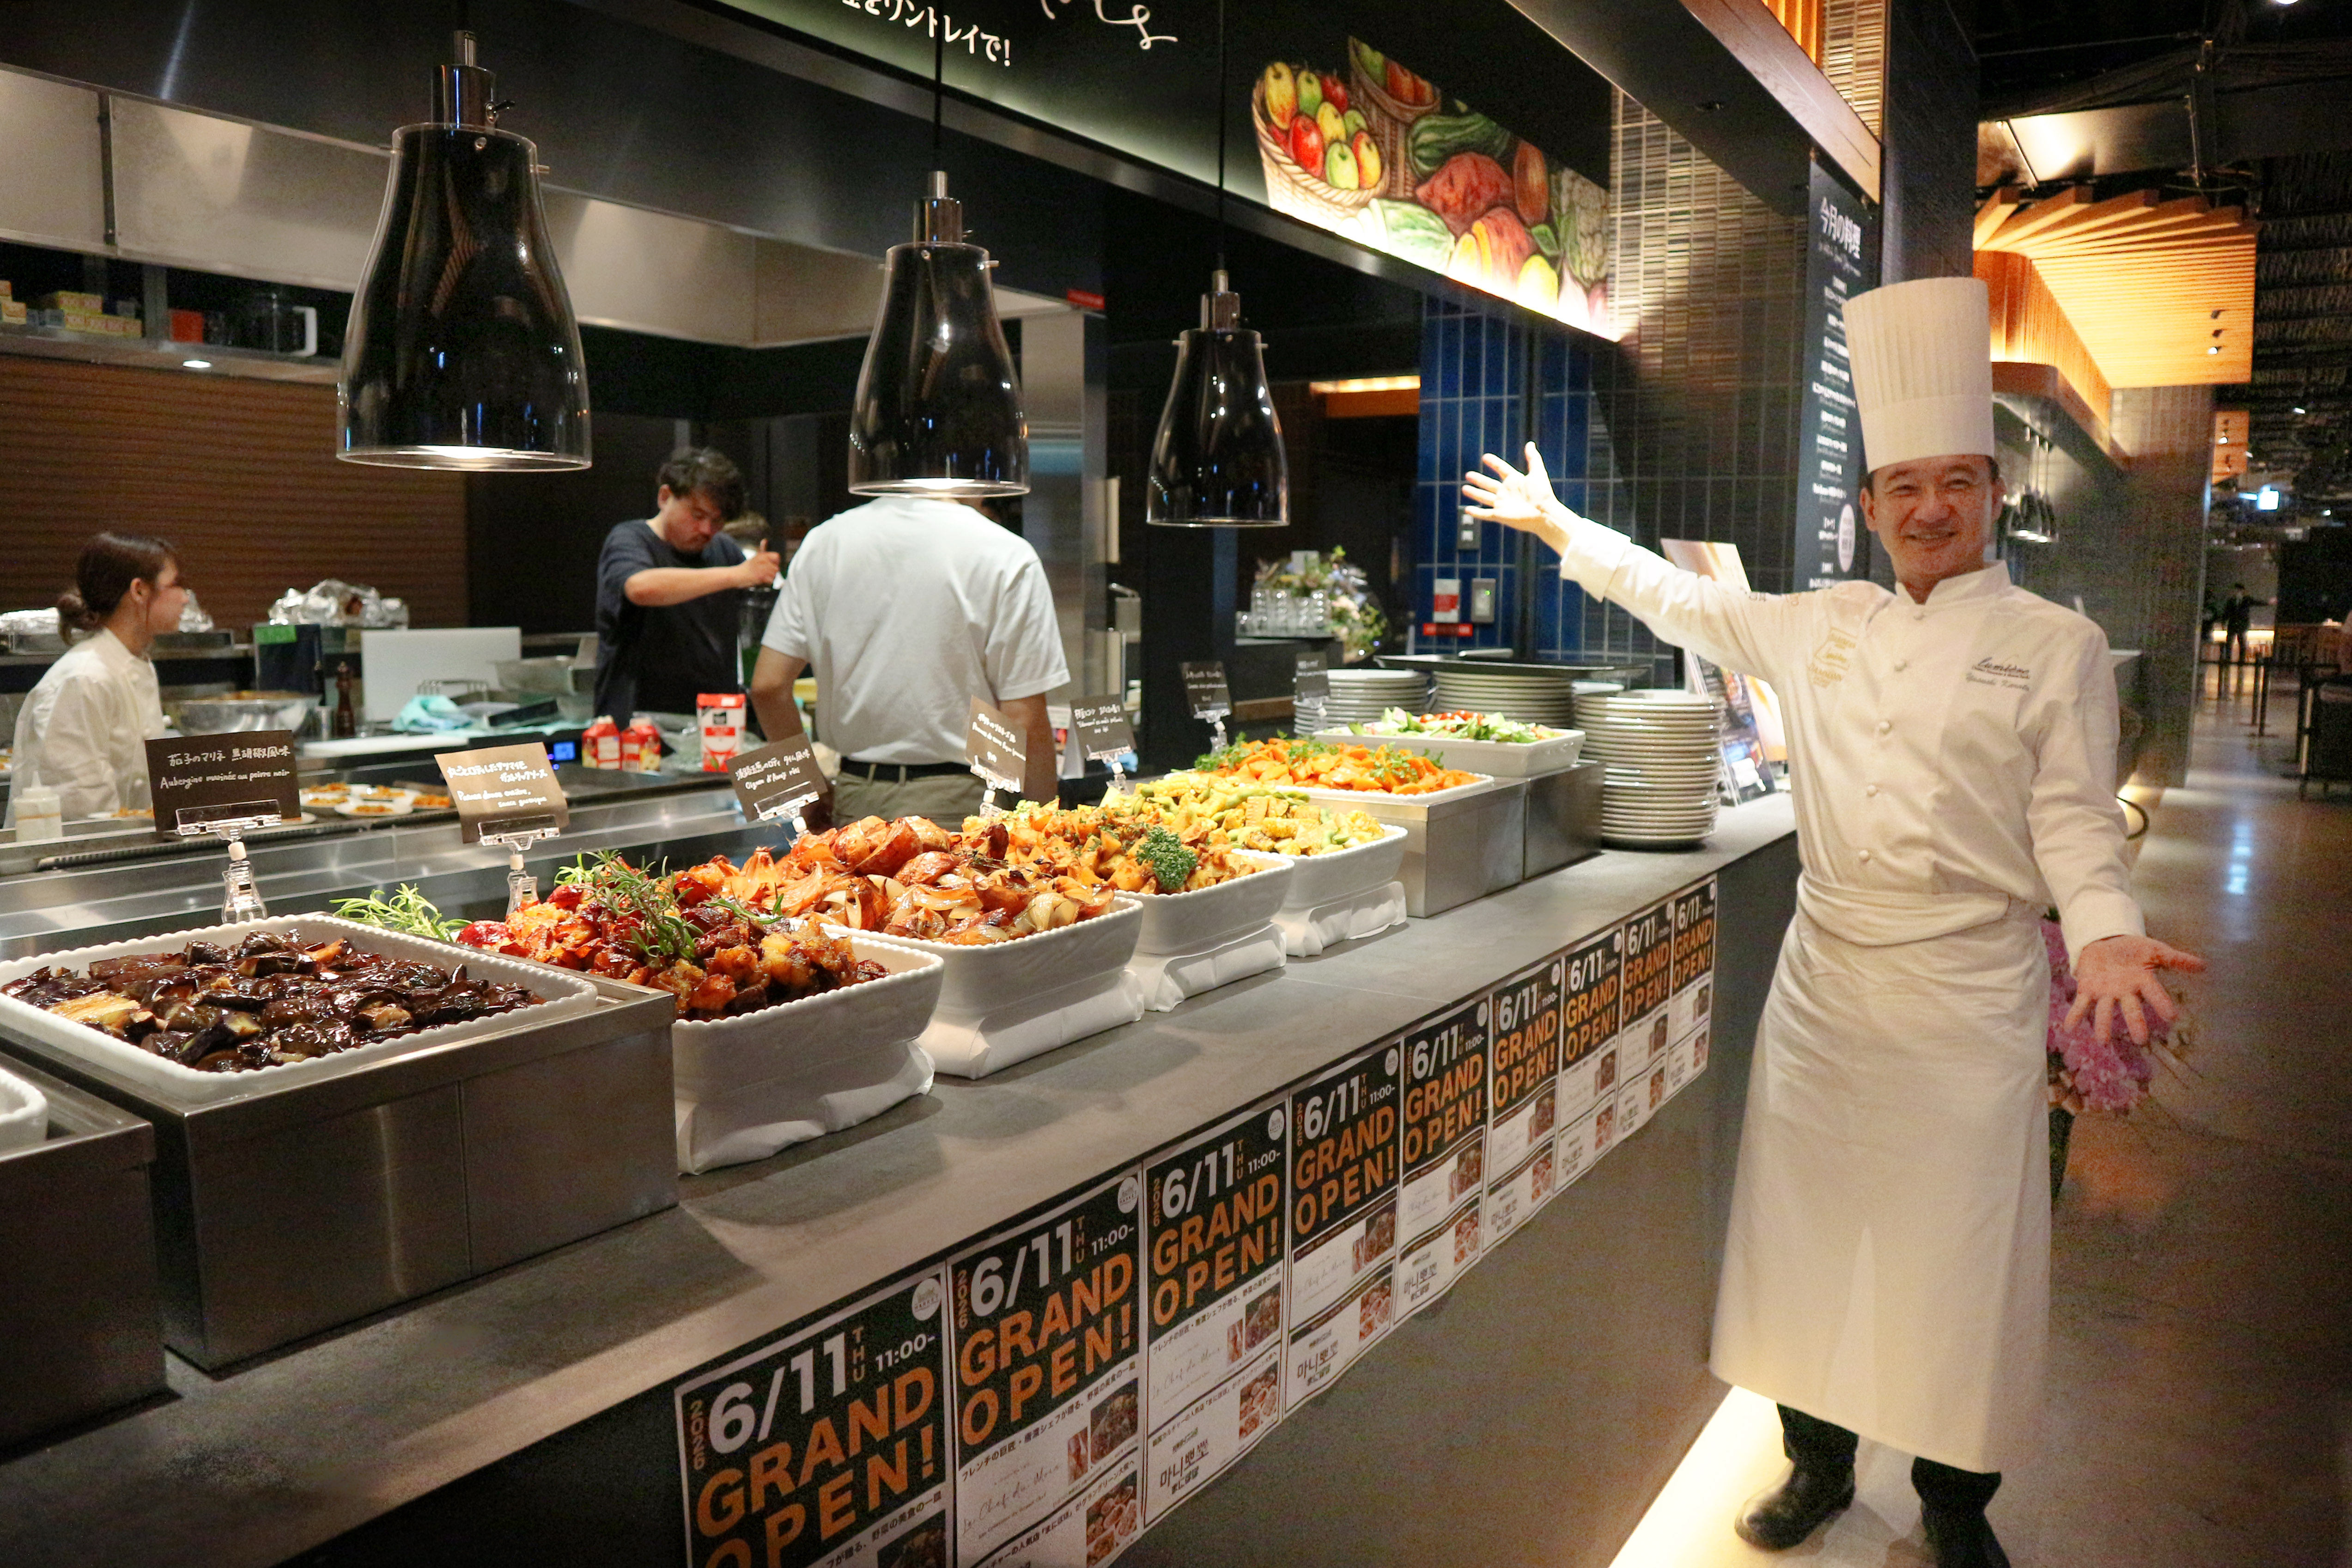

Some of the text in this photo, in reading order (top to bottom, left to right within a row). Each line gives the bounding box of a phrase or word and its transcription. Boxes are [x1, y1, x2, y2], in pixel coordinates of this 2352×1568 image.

[842, 0, 1010, 67] をワントレイで!
[160, 777, 203, 789] Aubergine
[167, 745, 291, 767] 茄子のマリネ 黒胡椒風味
[1628, 916, 1655, 955] 6/11
[1674, 918, 1713, 961] GRAND
[1678, 895, 1700, 930] 6/11
[1570, 948, 1603, 991] 6/11
[1623, 941, 1670, 990] GRAND
[1672, 944, 1711, 989] OPEN!
[1499, 982, 1538, 1031] 6/11
[1565, 974, 1617, 1029] GRAND
[1622, 970, 1668, 1022] OPEN!
[1412, 1023, 1459, 1080] 6/11
[1495, 1009, 1558, 1072] GRAND
[1565, 1005, 1616, 1062] OPEN!
[1369, 1084, 1396, 1105] 11:00-
[1405, 1053, 1483, 1124] GRAND
[1493, 1042, 1556, 1108] OPEN!
[1303, 1078, 1360, 1141] 6/11
[1403, 1089, 1483, 1163] OPEN!
[1248, 1149, 1281, 1175] 11:00-
[1295, 1105, 1395, 1190] GRAND
[1161, 1142, 1236, 1220] 6/11
[1295, 1145, 1395, 1235] OPEN!
[1075, 1215, 1085, 1264] THU
[1091, 1223, 1135, 1257] 11:00-
[1153, 1173, 1279, 1276] GRAND
[970, 1220, 1072, 1318] 6/11
[1153, 1216, 1279, 1326] OPEN!
[957, 1269, 968, 1330] 2026
[959, 1252, 1133, 1387] GRAND
[852, 1326, 865, 1383] THU
[875, 1333, 936, 1373] 11:00-
[961, 1302, 1132, 1446] OPEN!
[708, 1331, 846, 1454] 6/11
[689, 1400, 706, 1471] 2026
[697, 1366, 935, 1537] GRAND
